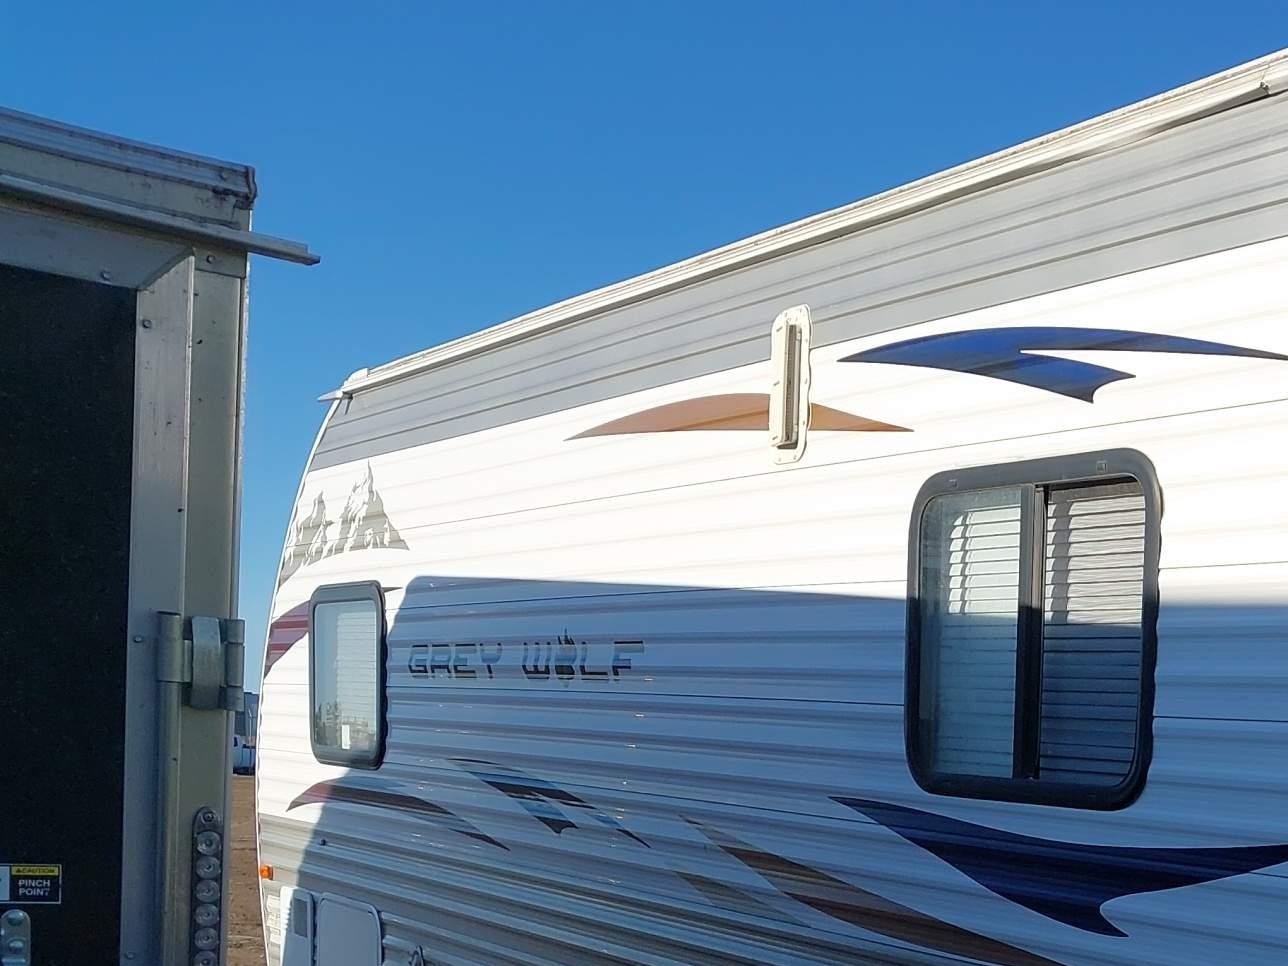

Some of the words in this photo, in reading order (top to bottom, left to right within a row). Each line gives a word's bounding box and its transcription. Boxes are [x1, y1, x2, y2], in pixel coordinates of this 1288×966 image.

[408, 642, 502, 679] GREY
[18, 879, 51, 887] PINCH
[19, 888, 50, 896] POINT
